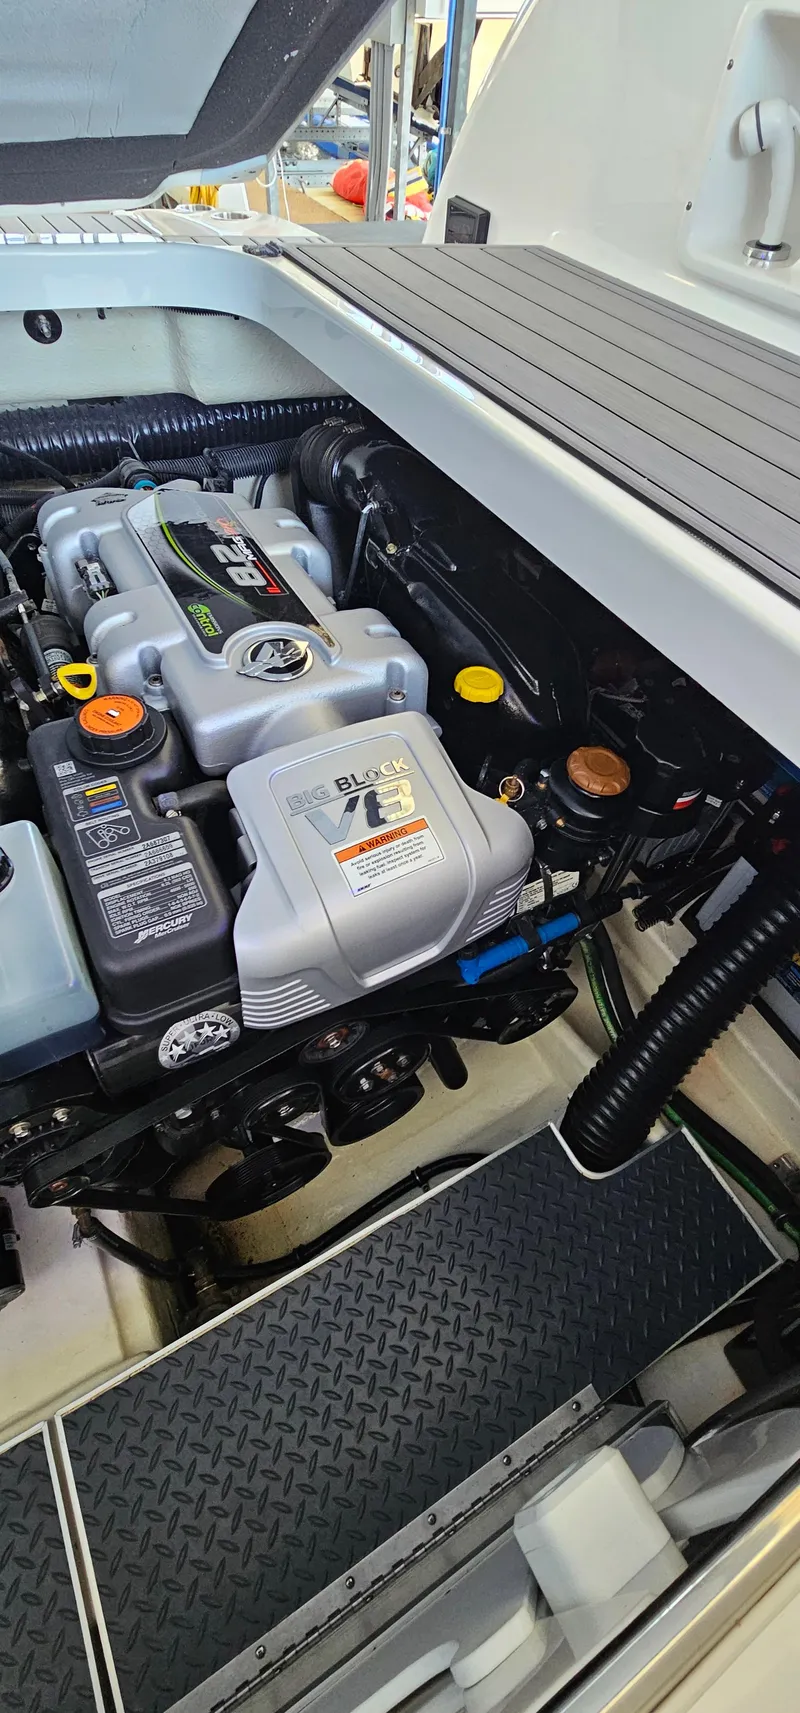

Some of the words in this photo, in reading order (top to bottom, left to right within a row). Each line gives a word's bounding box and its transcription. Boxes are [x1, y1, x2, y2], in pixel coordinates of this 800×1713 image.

[232, 536, 257, 561] MAG
[210, 544, 267, 587] 8.2
[286, 784, 330, 811] BIG
[333, 757, 410, 792] BLOCK
[304, 778, 416, 846] V8
[366, 827, 408, 849] WARNING
[350, 858, 365, 867] Avoid
[364, 851, 382, 861] serious
[381, 845, 396, 855] injury
[400, 838, 414, 847] death
[359, 866, 377, 877] leaking
[403, 848, 421, 859] system
[370, 852, 394, 865] explosion
[393, 844, 414, 856] resulting
[412, 840, 424, 848] from
[367, 871, 381, 879] leaks
[385, 864, 398, 872] least
[397, 860, 410, 868] once
[126, 872, 166, 889] SPECIFICATIONS
[103, 893, 121, 903] MODEL
[105, 889, 144, 907] DISPLACEMENT
[106, 900, 126, 911] ENGINE
[126, 891, 152, 904] ROTATION
[136, 897, 149, 905] RPM
[110, 911, 134, 923] IGNITION
[113, 921, 131, 931] SPARK
[114, 925, 133, 935] SPARK
[132, 920, 148, 929] PLUG
[133, 913, 193, 944] MERCURY
[154, 922, 191, 939] MerCruiser
[161, 1025, 182, 1052] SUPER
[216, 1013, 234, 1026] LOW
